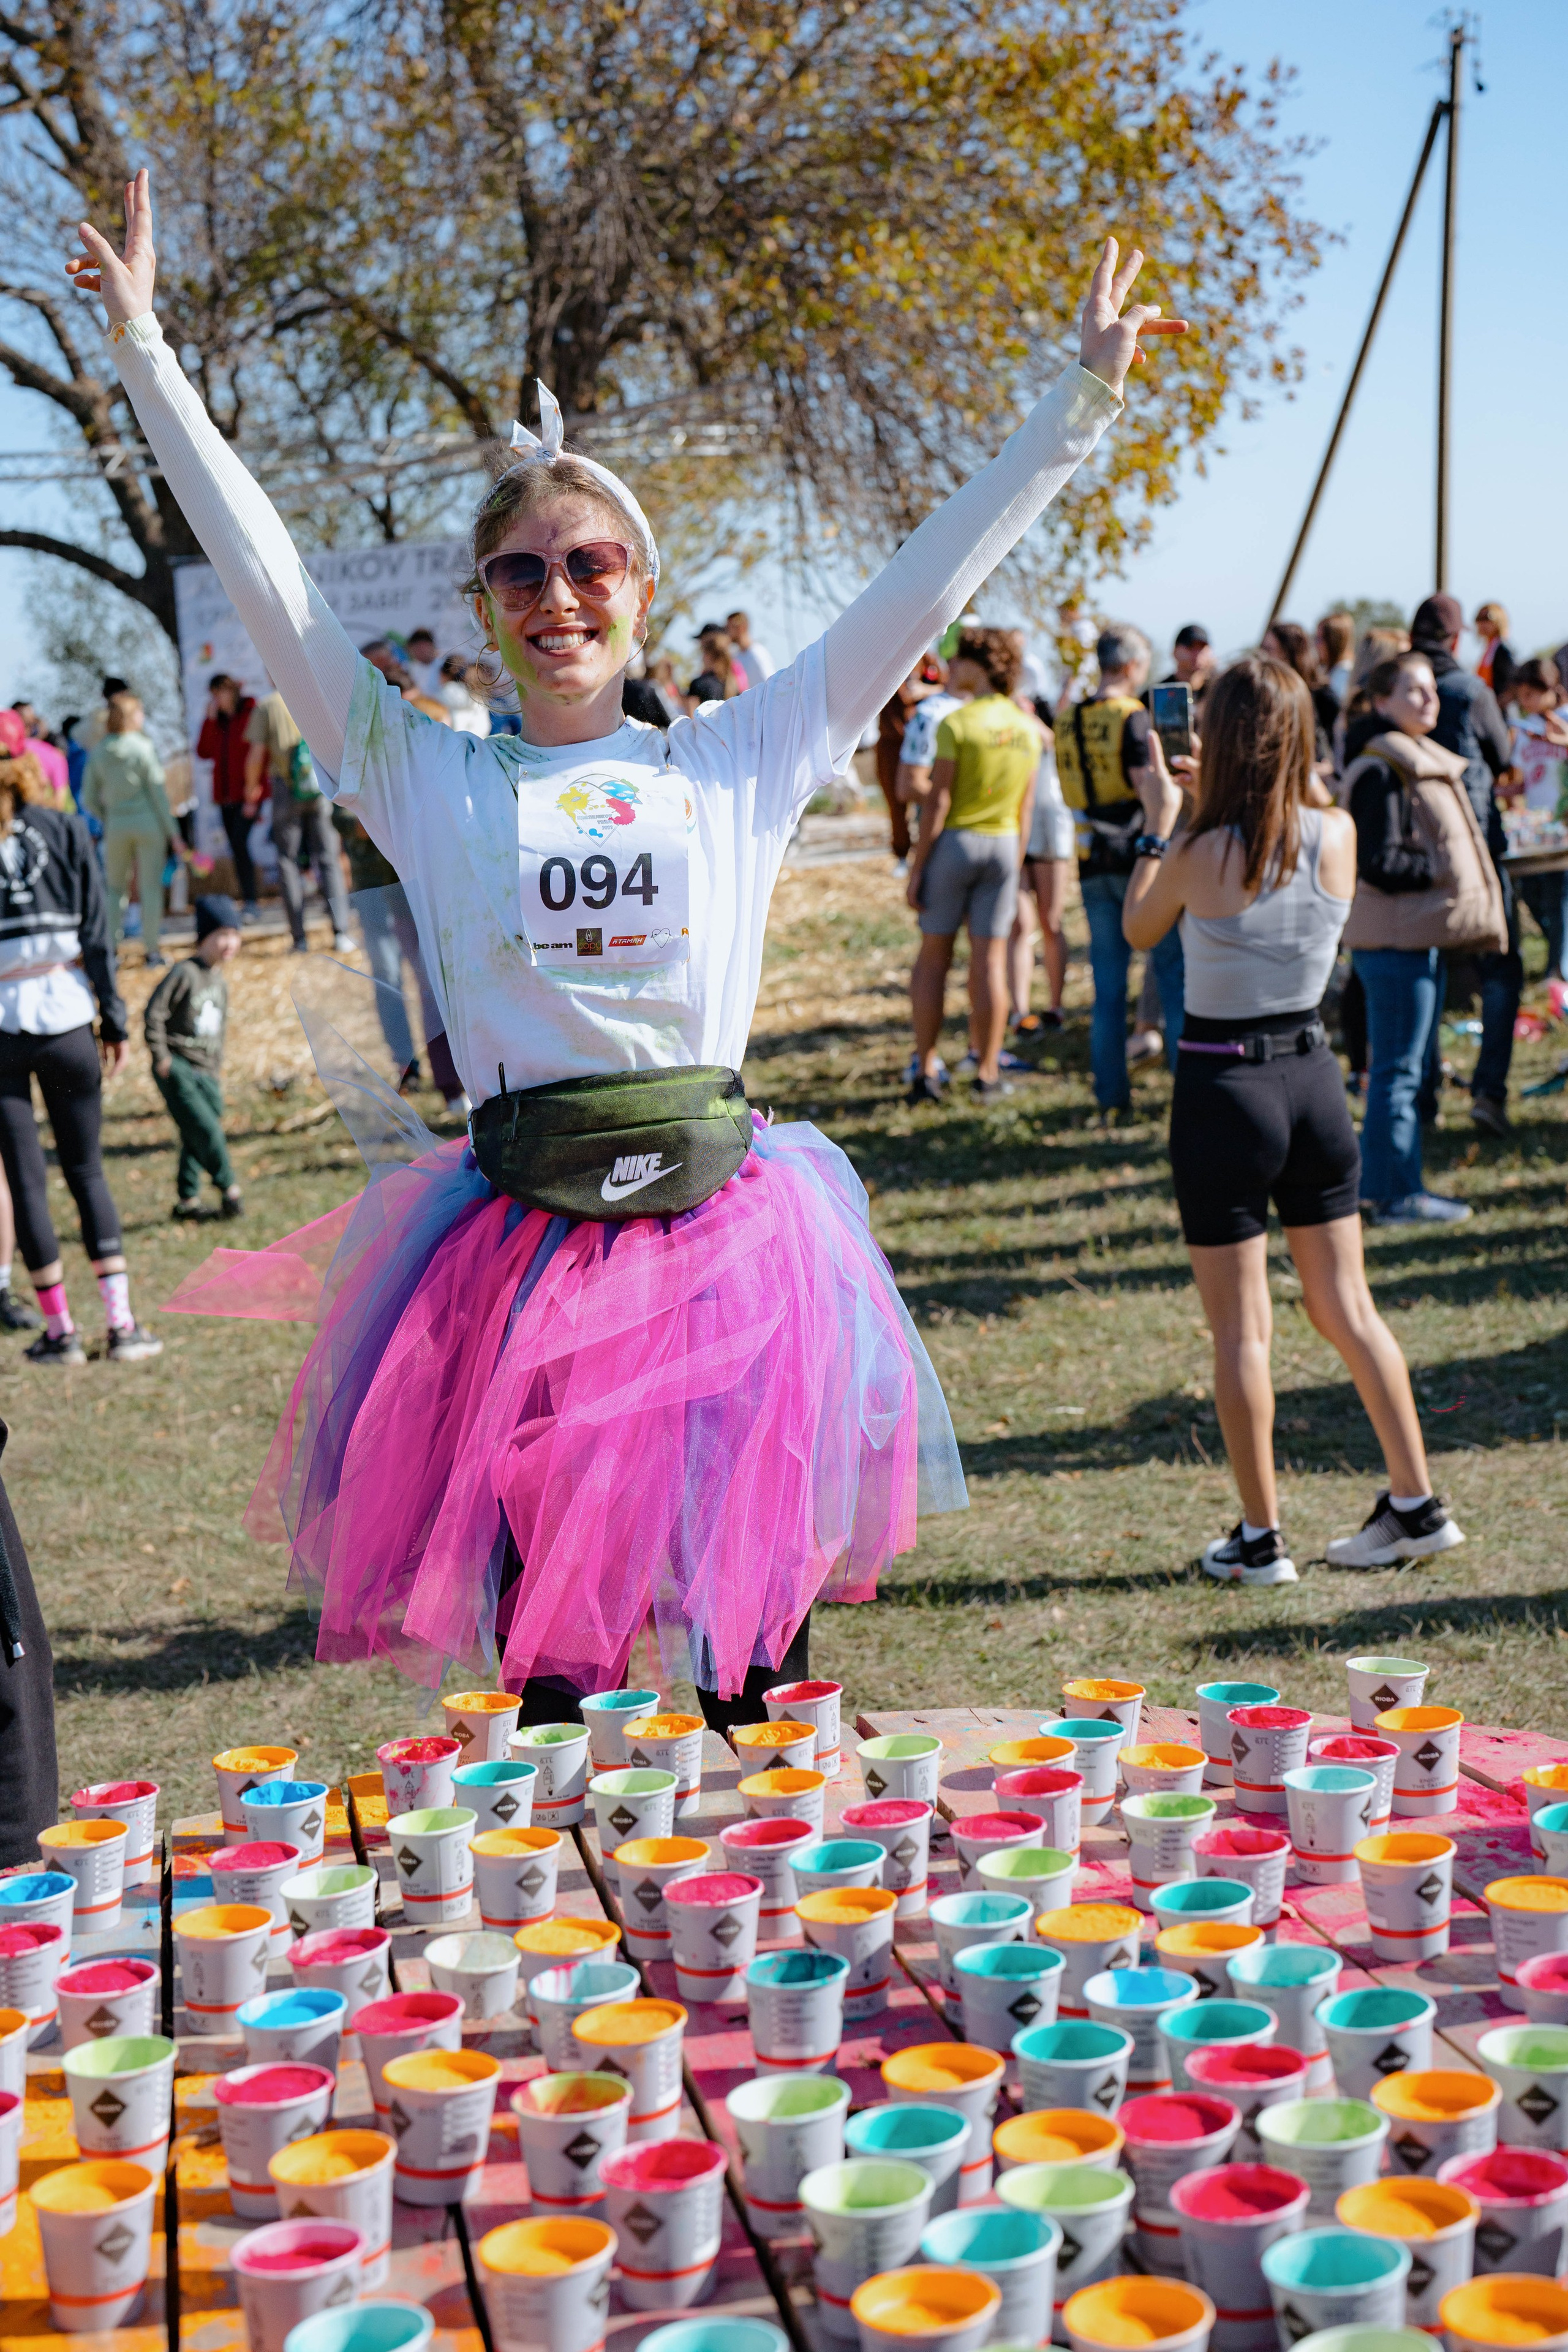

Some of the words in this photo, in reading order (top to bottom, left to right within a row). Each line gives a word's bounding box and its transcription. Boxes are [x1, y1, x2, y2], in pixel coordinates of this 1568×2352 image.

[539, 853, 658, 911] 094
[611, 1152, 663, 1183] NIKE
[497, 1803, 516, 1811] RIOBA
